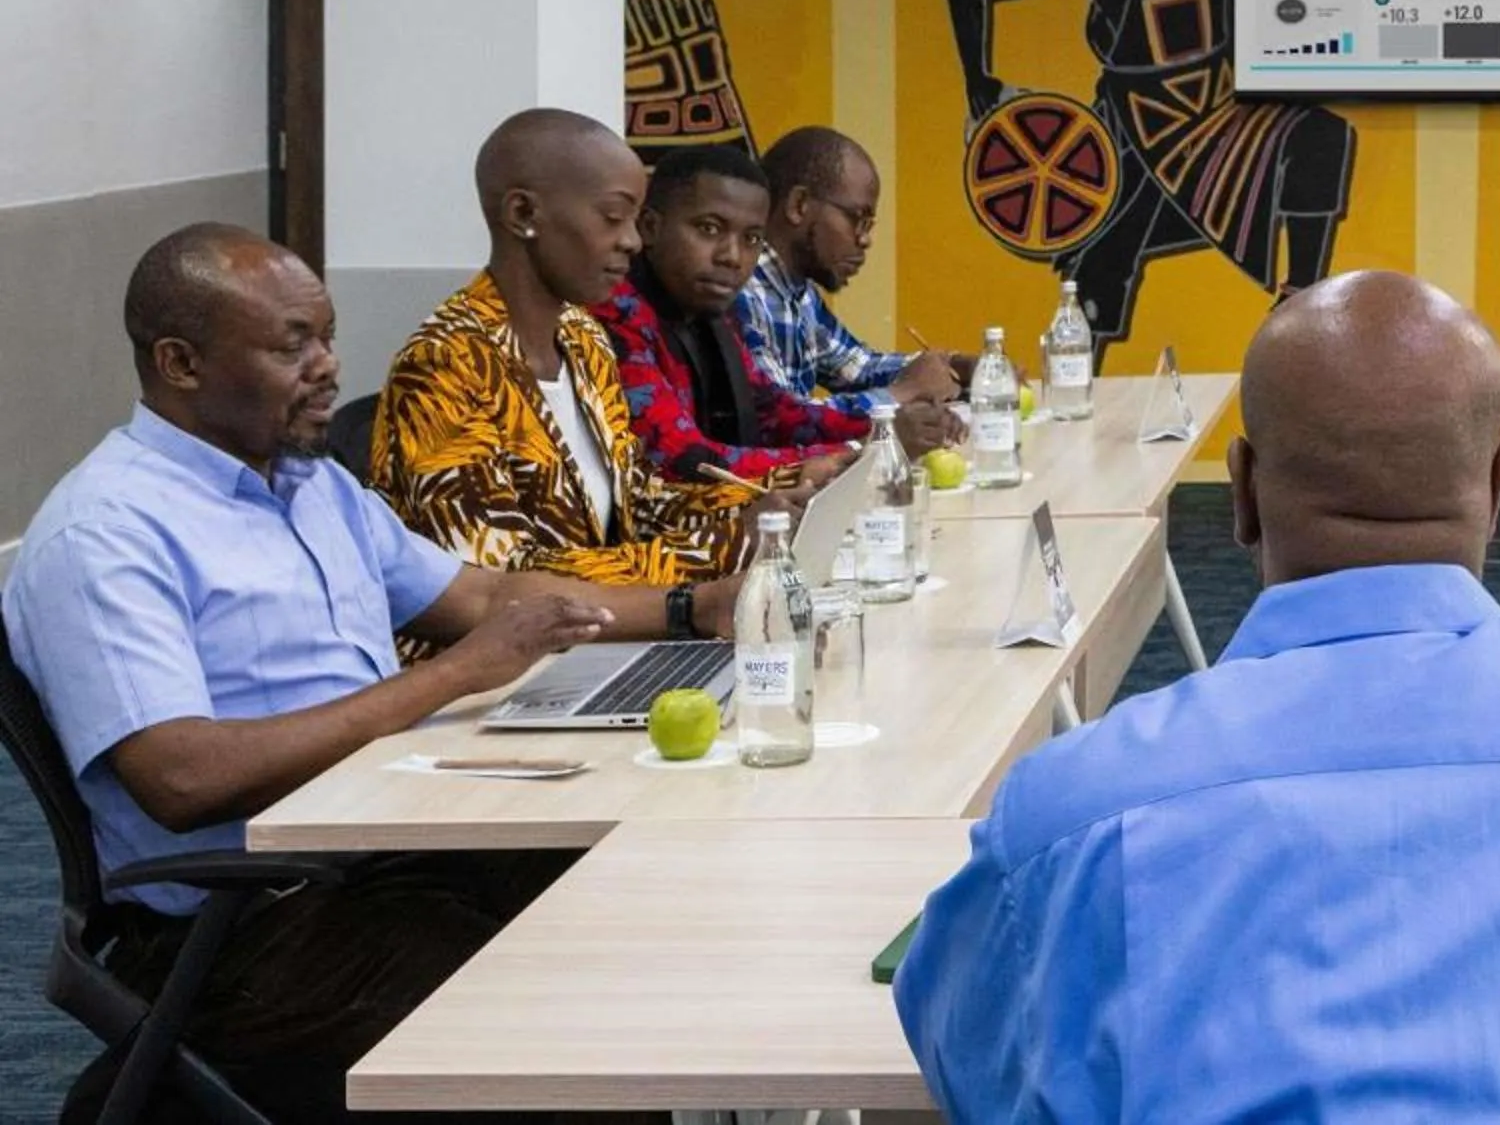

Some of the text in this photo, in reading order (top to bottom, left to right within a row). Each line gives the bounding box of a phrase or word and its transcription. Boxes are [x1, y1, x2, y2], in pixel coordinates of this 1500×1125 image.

[1381, 8, 1419, 23] +10.3
[1444, 5, 1483, 20] +12.0
[745, 660, 789, 674] MAYERS
